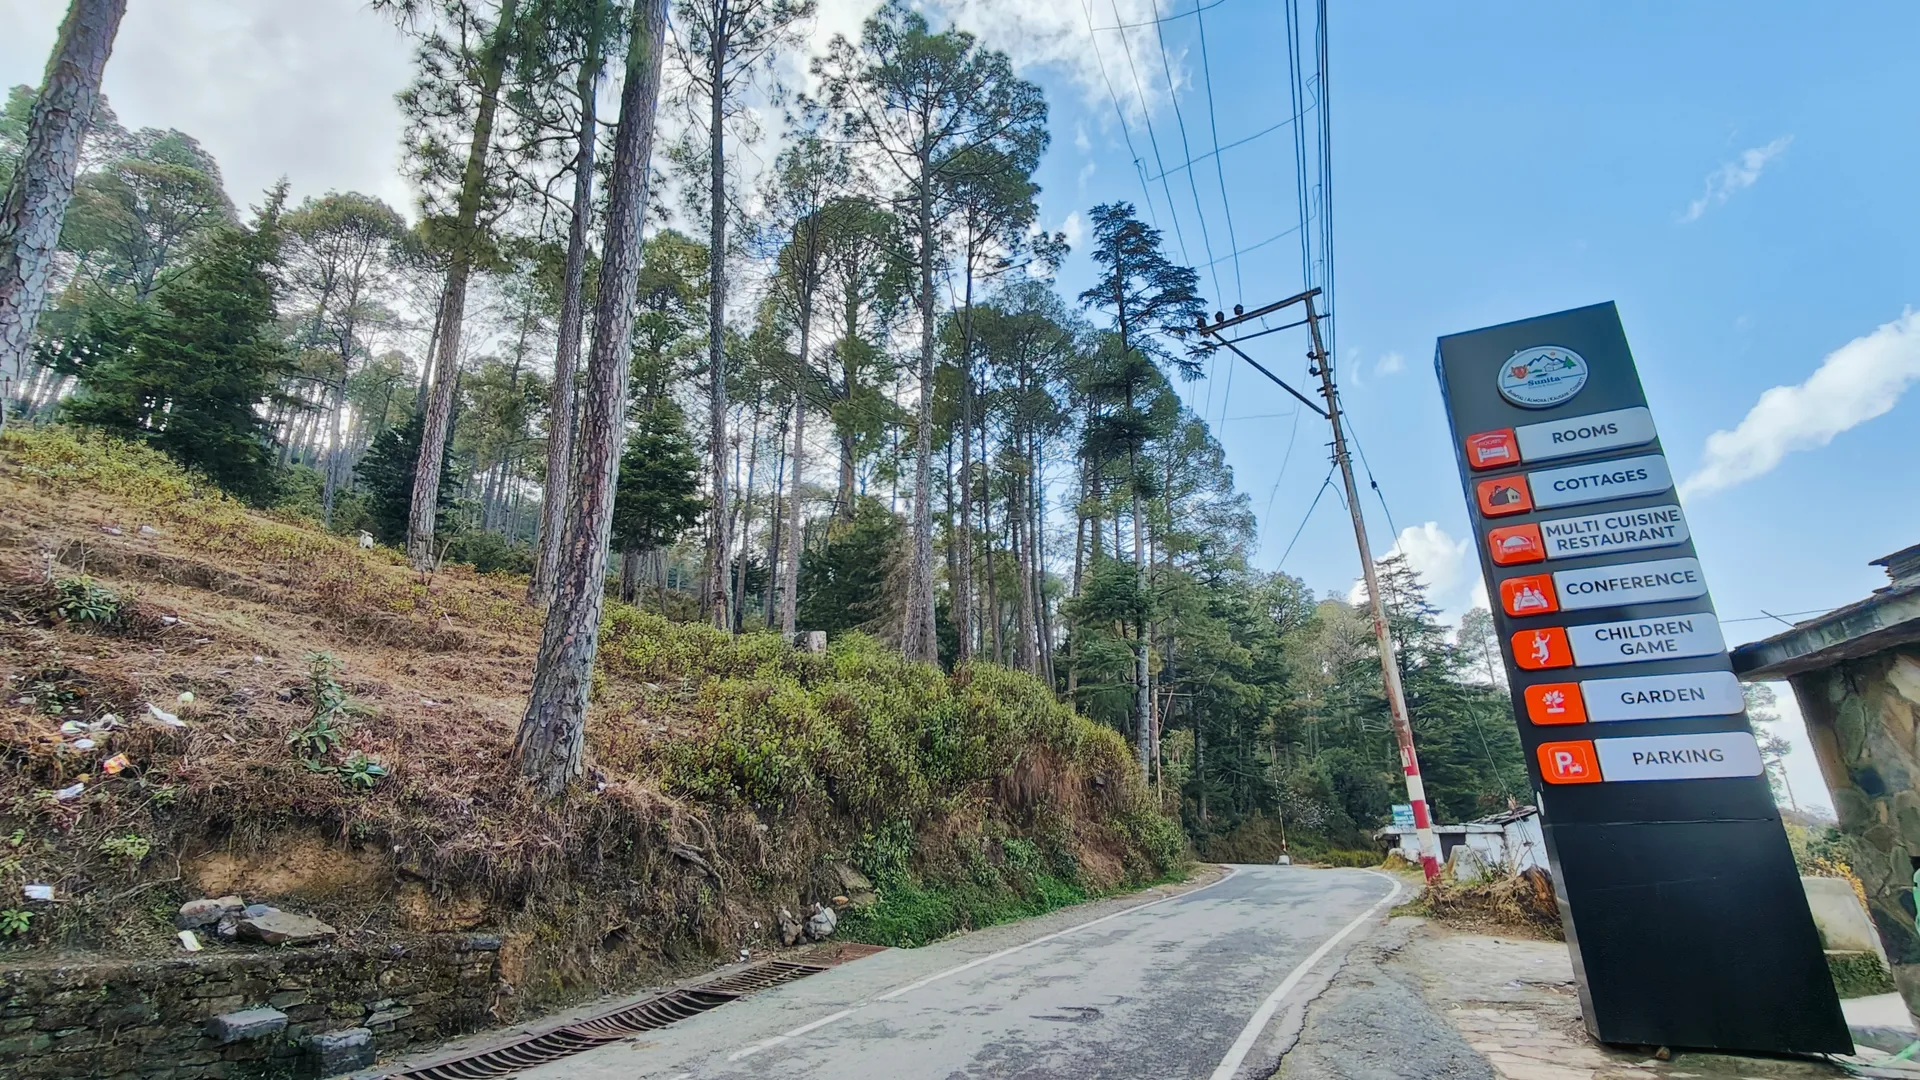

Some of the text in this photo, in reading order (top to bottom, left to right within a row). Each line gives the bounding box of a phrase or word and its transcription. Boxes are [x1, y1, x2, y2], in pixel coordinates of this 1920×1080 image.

[1527, 376, 1561, 387] Sunita
[1552, 422, 1618, 444] ROOMS
[1553, 468, 1648, 492] COTTAGES
[1545, 509, 1681, 538] MULTI CUISINE
[1556, 525, 1676, 551] RESTAURANT
[1566, 570, 1697, 595] CONFERENCE
[1594, 620, 1694, 642] CHILDREN
[1620, 639, 1677, 656] GAME
[1621, 687, 1705, 705] GARDEN
[1632, 748, 1724, 766] PARKING
